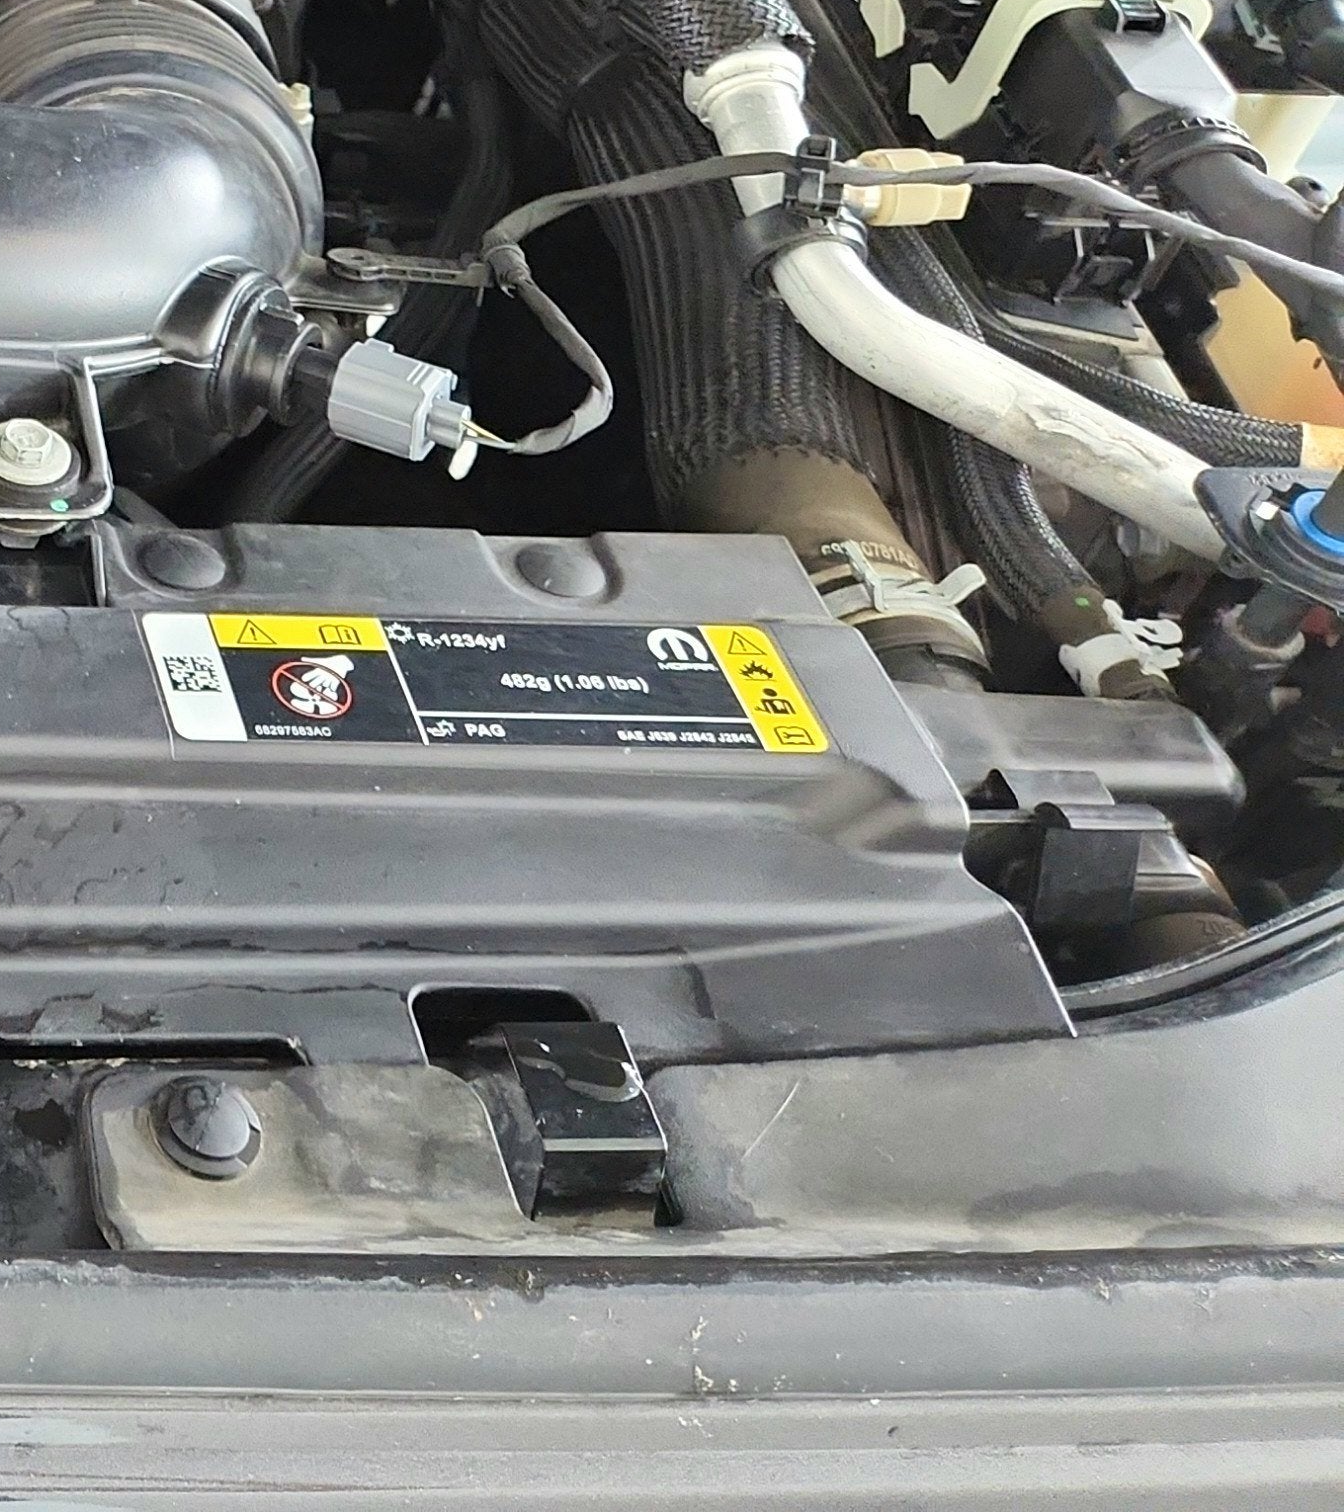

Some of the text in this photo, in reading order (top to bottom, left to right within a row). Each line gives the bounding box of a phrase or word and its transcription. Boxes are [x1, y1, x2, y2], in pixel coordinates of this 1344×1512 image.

[416, 632, 506, 651] R-1234yf
[657, 661, 719, 672] MOPAR
[500, 673, 552, 692] 482g
[606, 675, 649, 694] lbs)
[464, 723, 506, 738] PAG
[616, 730, 646, 742] SAE
